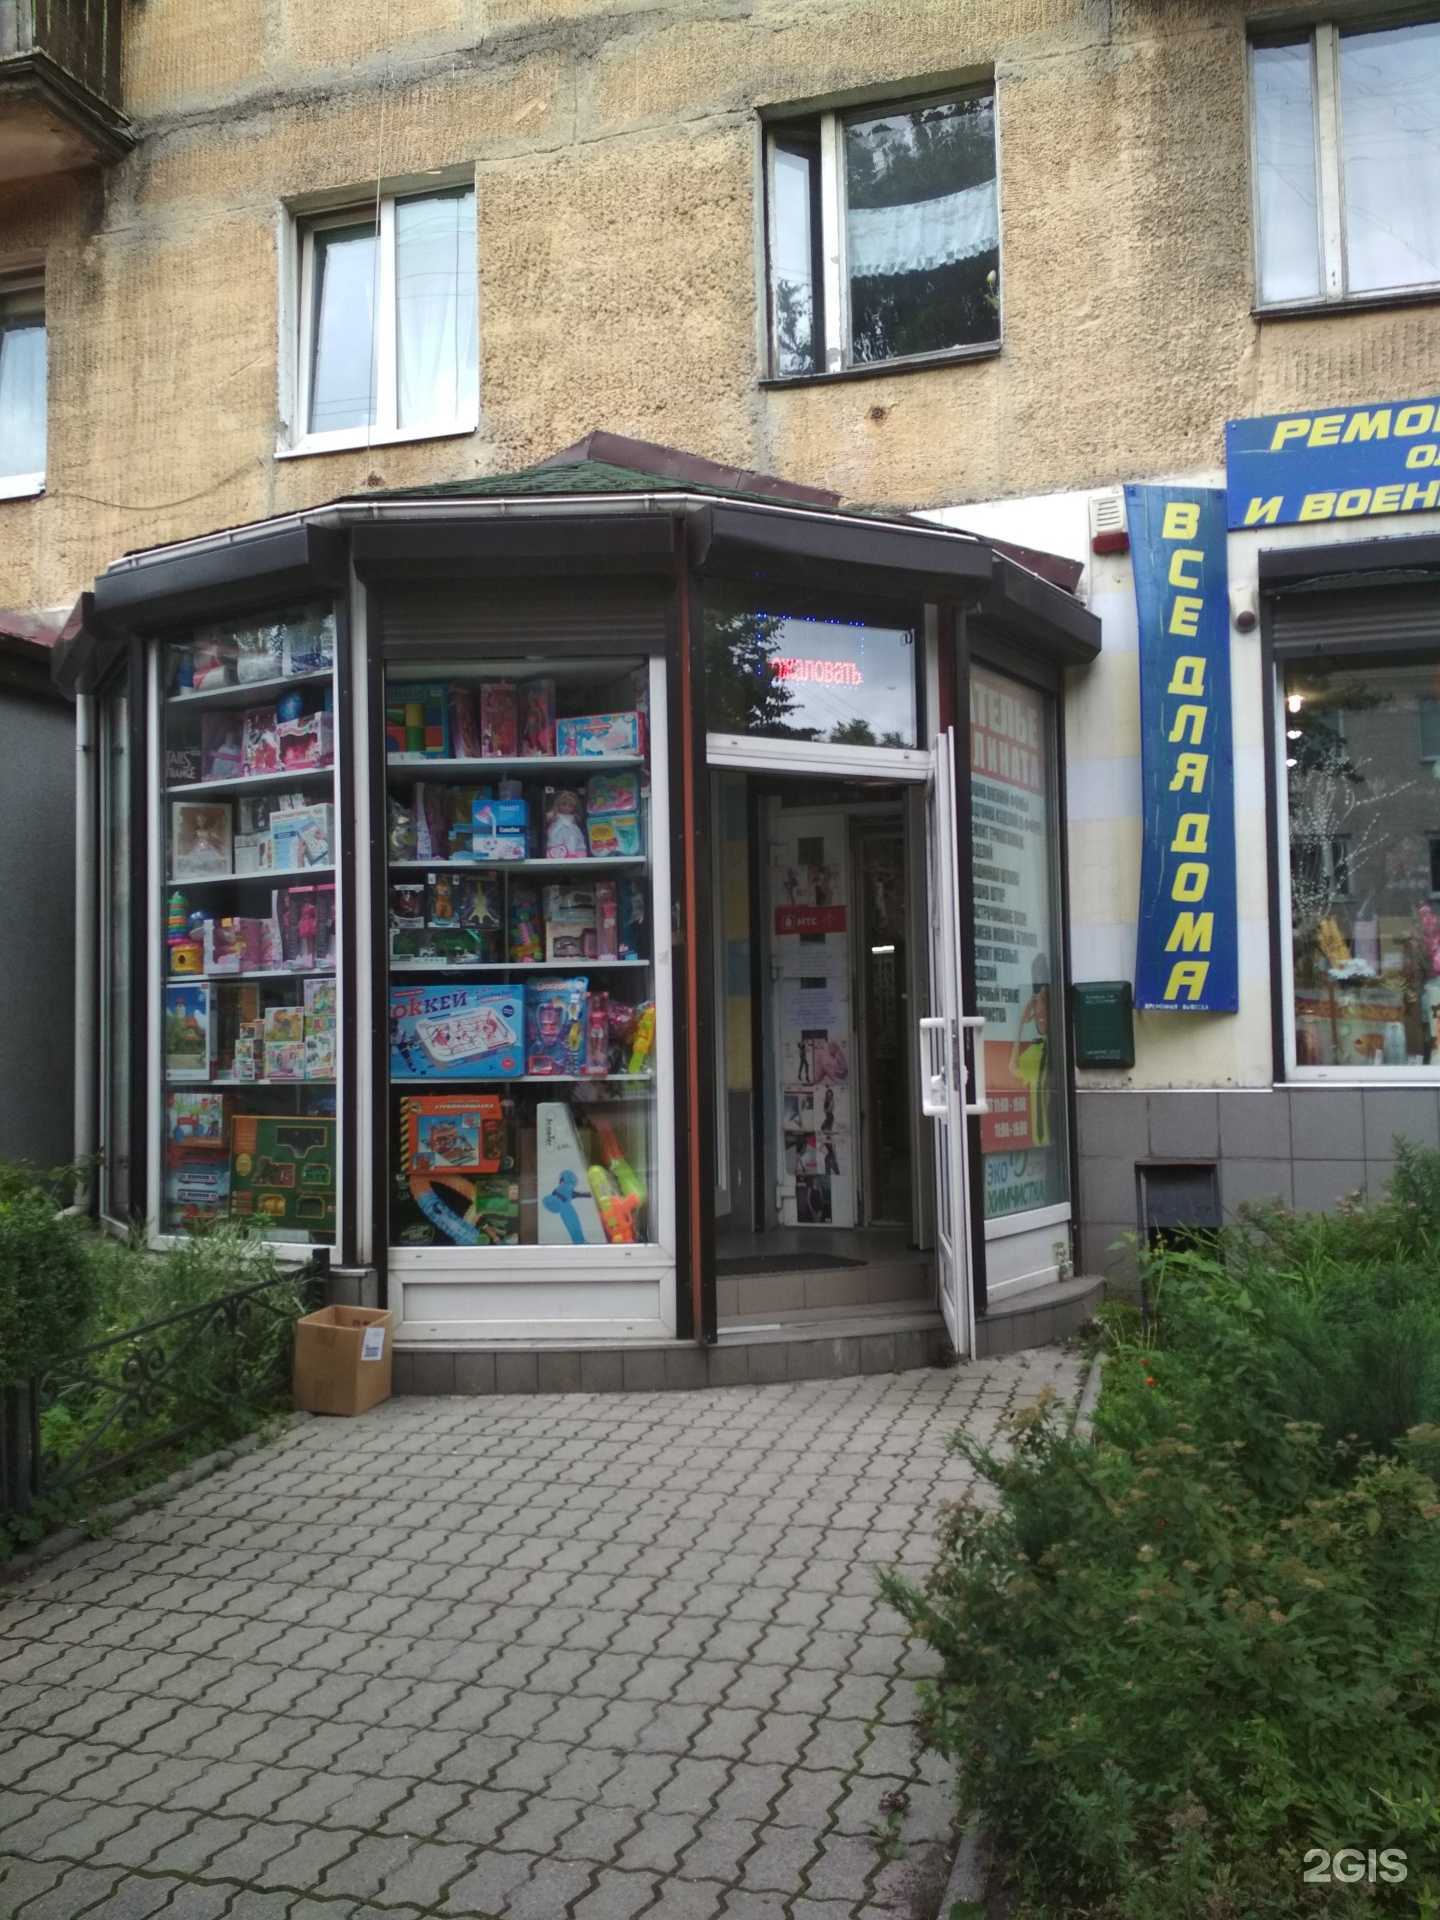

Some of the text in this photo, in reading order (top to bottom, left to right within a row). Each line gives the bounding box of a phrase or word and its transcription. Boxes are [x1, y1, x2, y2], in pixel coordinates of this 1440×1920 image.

[1270, 404, 1440, 451] РЕМО
[1405, 443, 1440, 470] О
[1243, 479, 1440, 526] И ВОЕН
[1162, 502, 1215, 1001] ВСЕ ДЛЯ ДОМА
